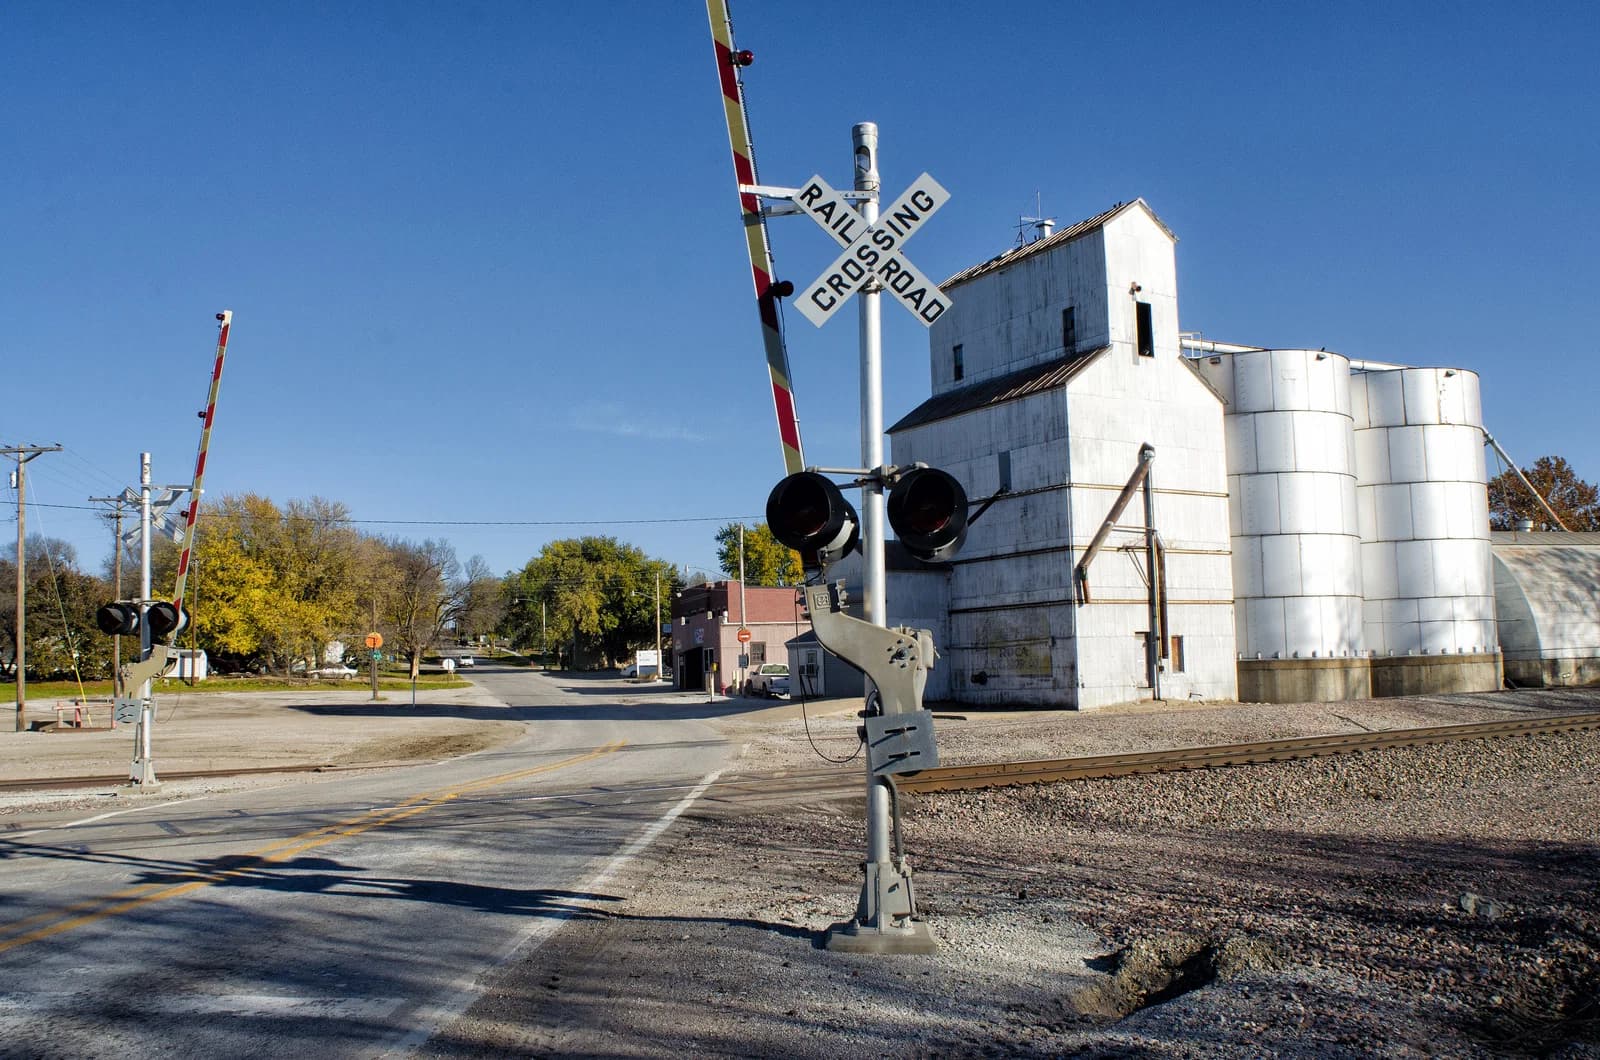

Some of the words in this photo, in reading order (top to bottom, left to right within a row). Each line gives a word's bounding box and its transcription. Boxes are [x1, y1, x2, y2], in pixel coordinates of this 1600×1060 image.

[800, 183, 853, 244] RAIL
[877, 258, 945, 323] ROAD
[811, 190, 934, 312] CROSSING
